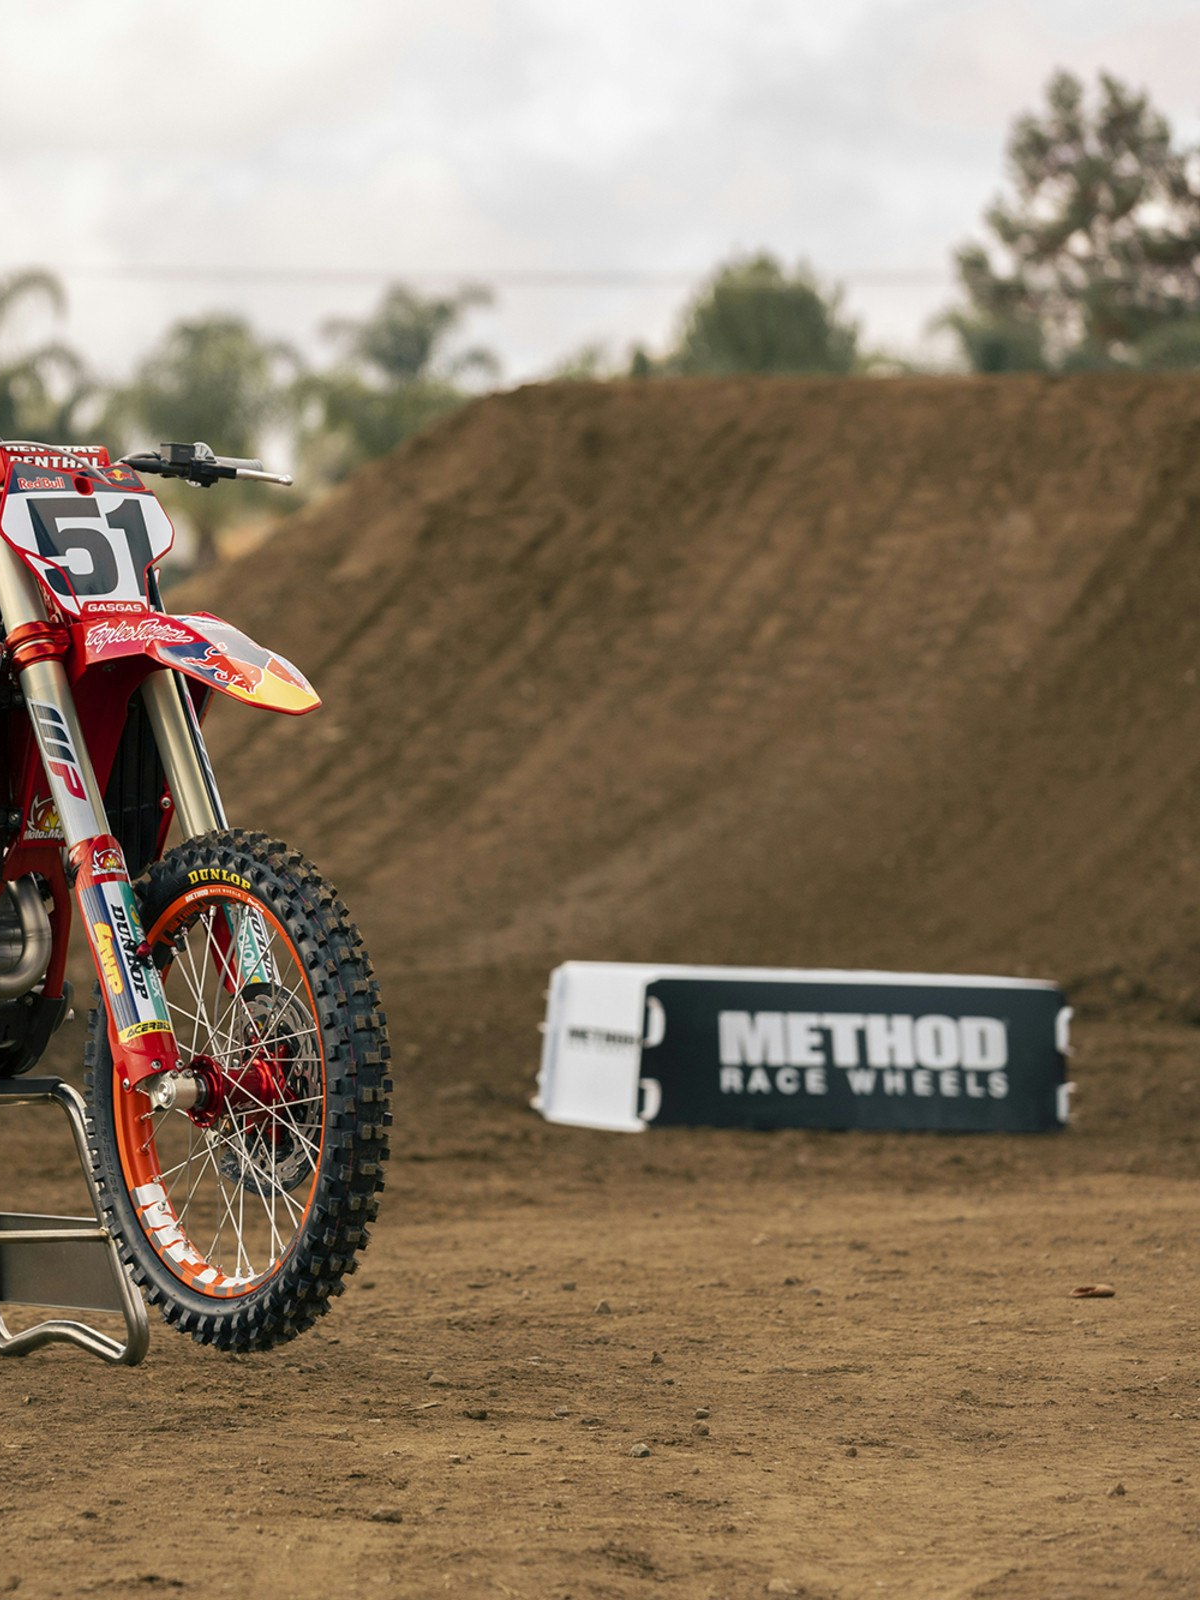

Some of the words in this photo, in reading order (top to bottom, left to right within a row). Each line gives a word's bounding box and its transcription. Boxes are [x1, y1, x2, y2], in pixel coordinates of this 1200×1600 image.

[17, 477, 42, 490] Red
[43, 477, 66, 490] Bull
[26, 498, 147, 596] 51
[88, 603, 142, 613] GASGAS
[188, 868, 251, 890] DUNLOP
[718, 1010, 1008, 1071] METHOD
[720, 1067, 828, 1094] RACE
[847, 1069, 1008, 1098] WHEELS
